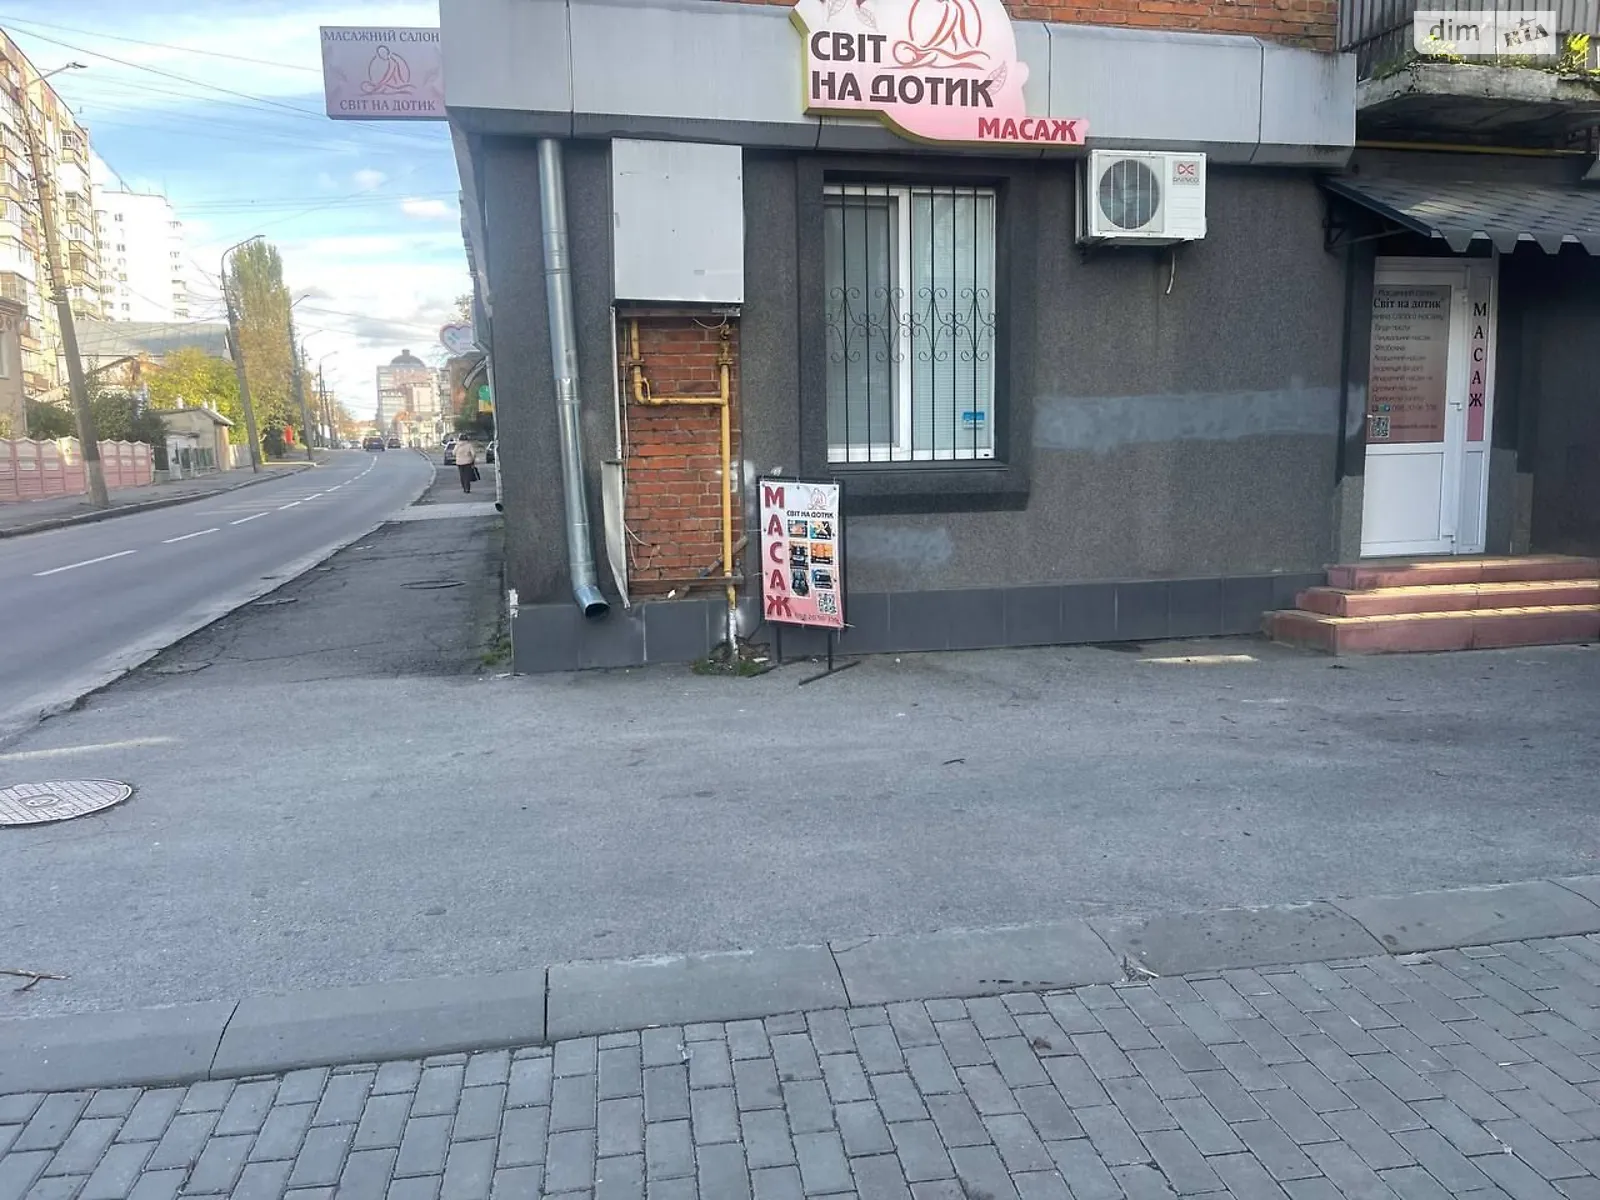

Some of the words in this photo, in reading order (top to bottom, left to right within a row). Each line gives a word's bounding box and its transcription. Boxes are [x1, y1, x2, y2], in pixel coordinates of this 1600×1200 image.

[324, 30, 396, 42] МАСАЖНИЙ
[399, 31, 439, 43] САЛОН
[811, 31, 887, 63] СВІТ
[340, 99, 368, 110] СВІТ
[371, 100, 391, 111] НА
[392, 100, 436, 111] ДОТИК
[812, 71, 862, 101] НА
[869, 75, 995, 107] ДОТИК
[978, 117, 1078, 142] МАСАЖ
[1469, 302, 1487, 407] МАСАЖ
[764, 485, 792, 618] МАСАЖ
